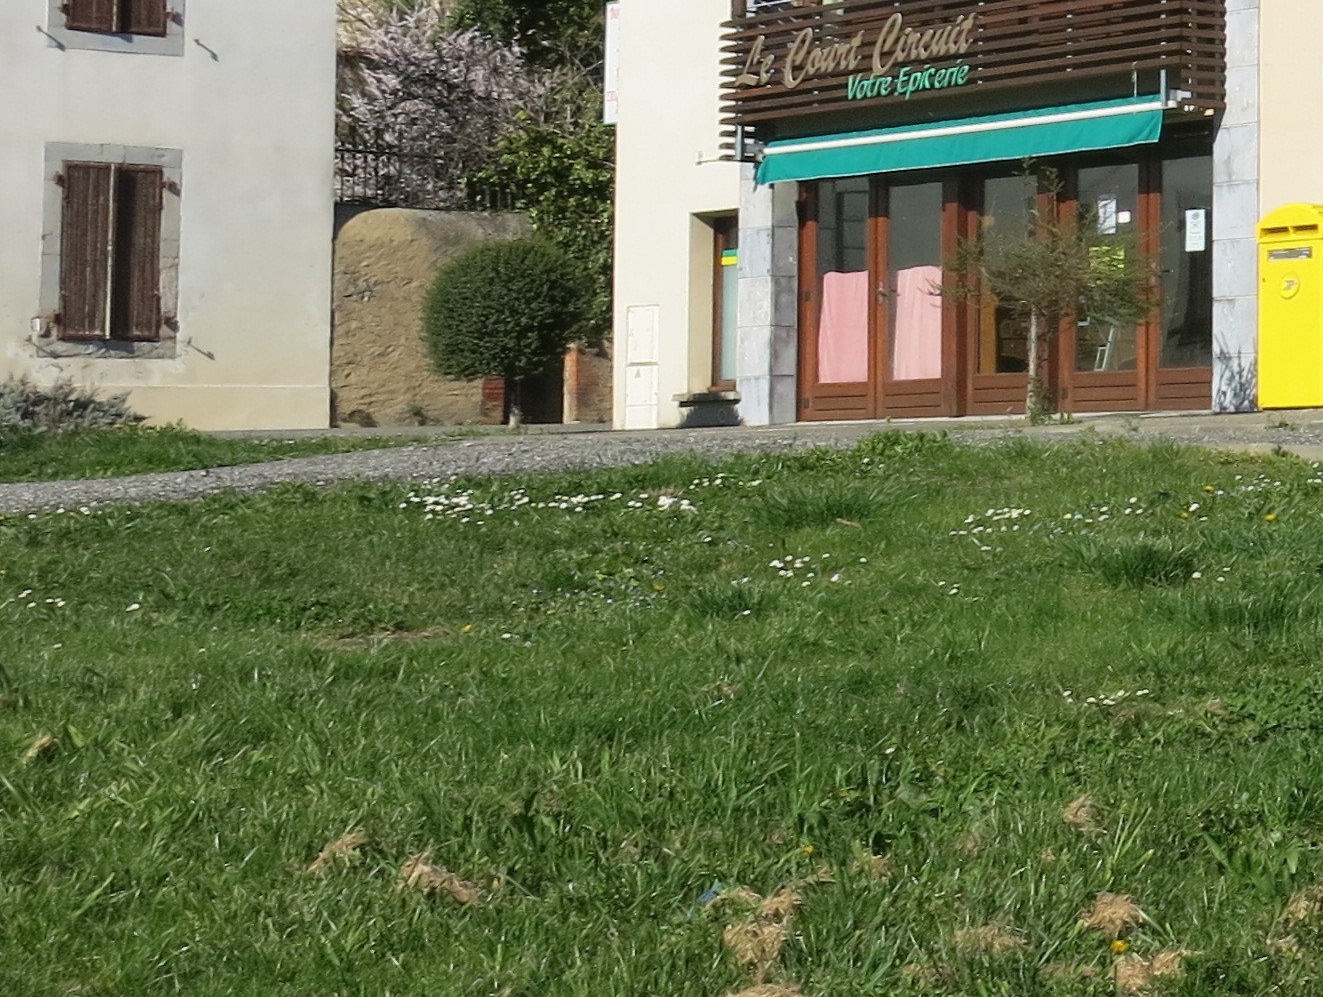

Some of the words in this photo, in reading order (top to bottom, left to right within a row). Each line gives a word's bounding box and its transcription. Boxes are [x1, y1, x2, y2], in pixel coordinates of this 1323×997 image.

[735, 35, 775, 87] Le
[783, 27, 865, 89] Court
[872, 12, 977, 76] Circuit
[847, 73, 892, 101] Votre
[895, 58, 971, 101] Epicerie
